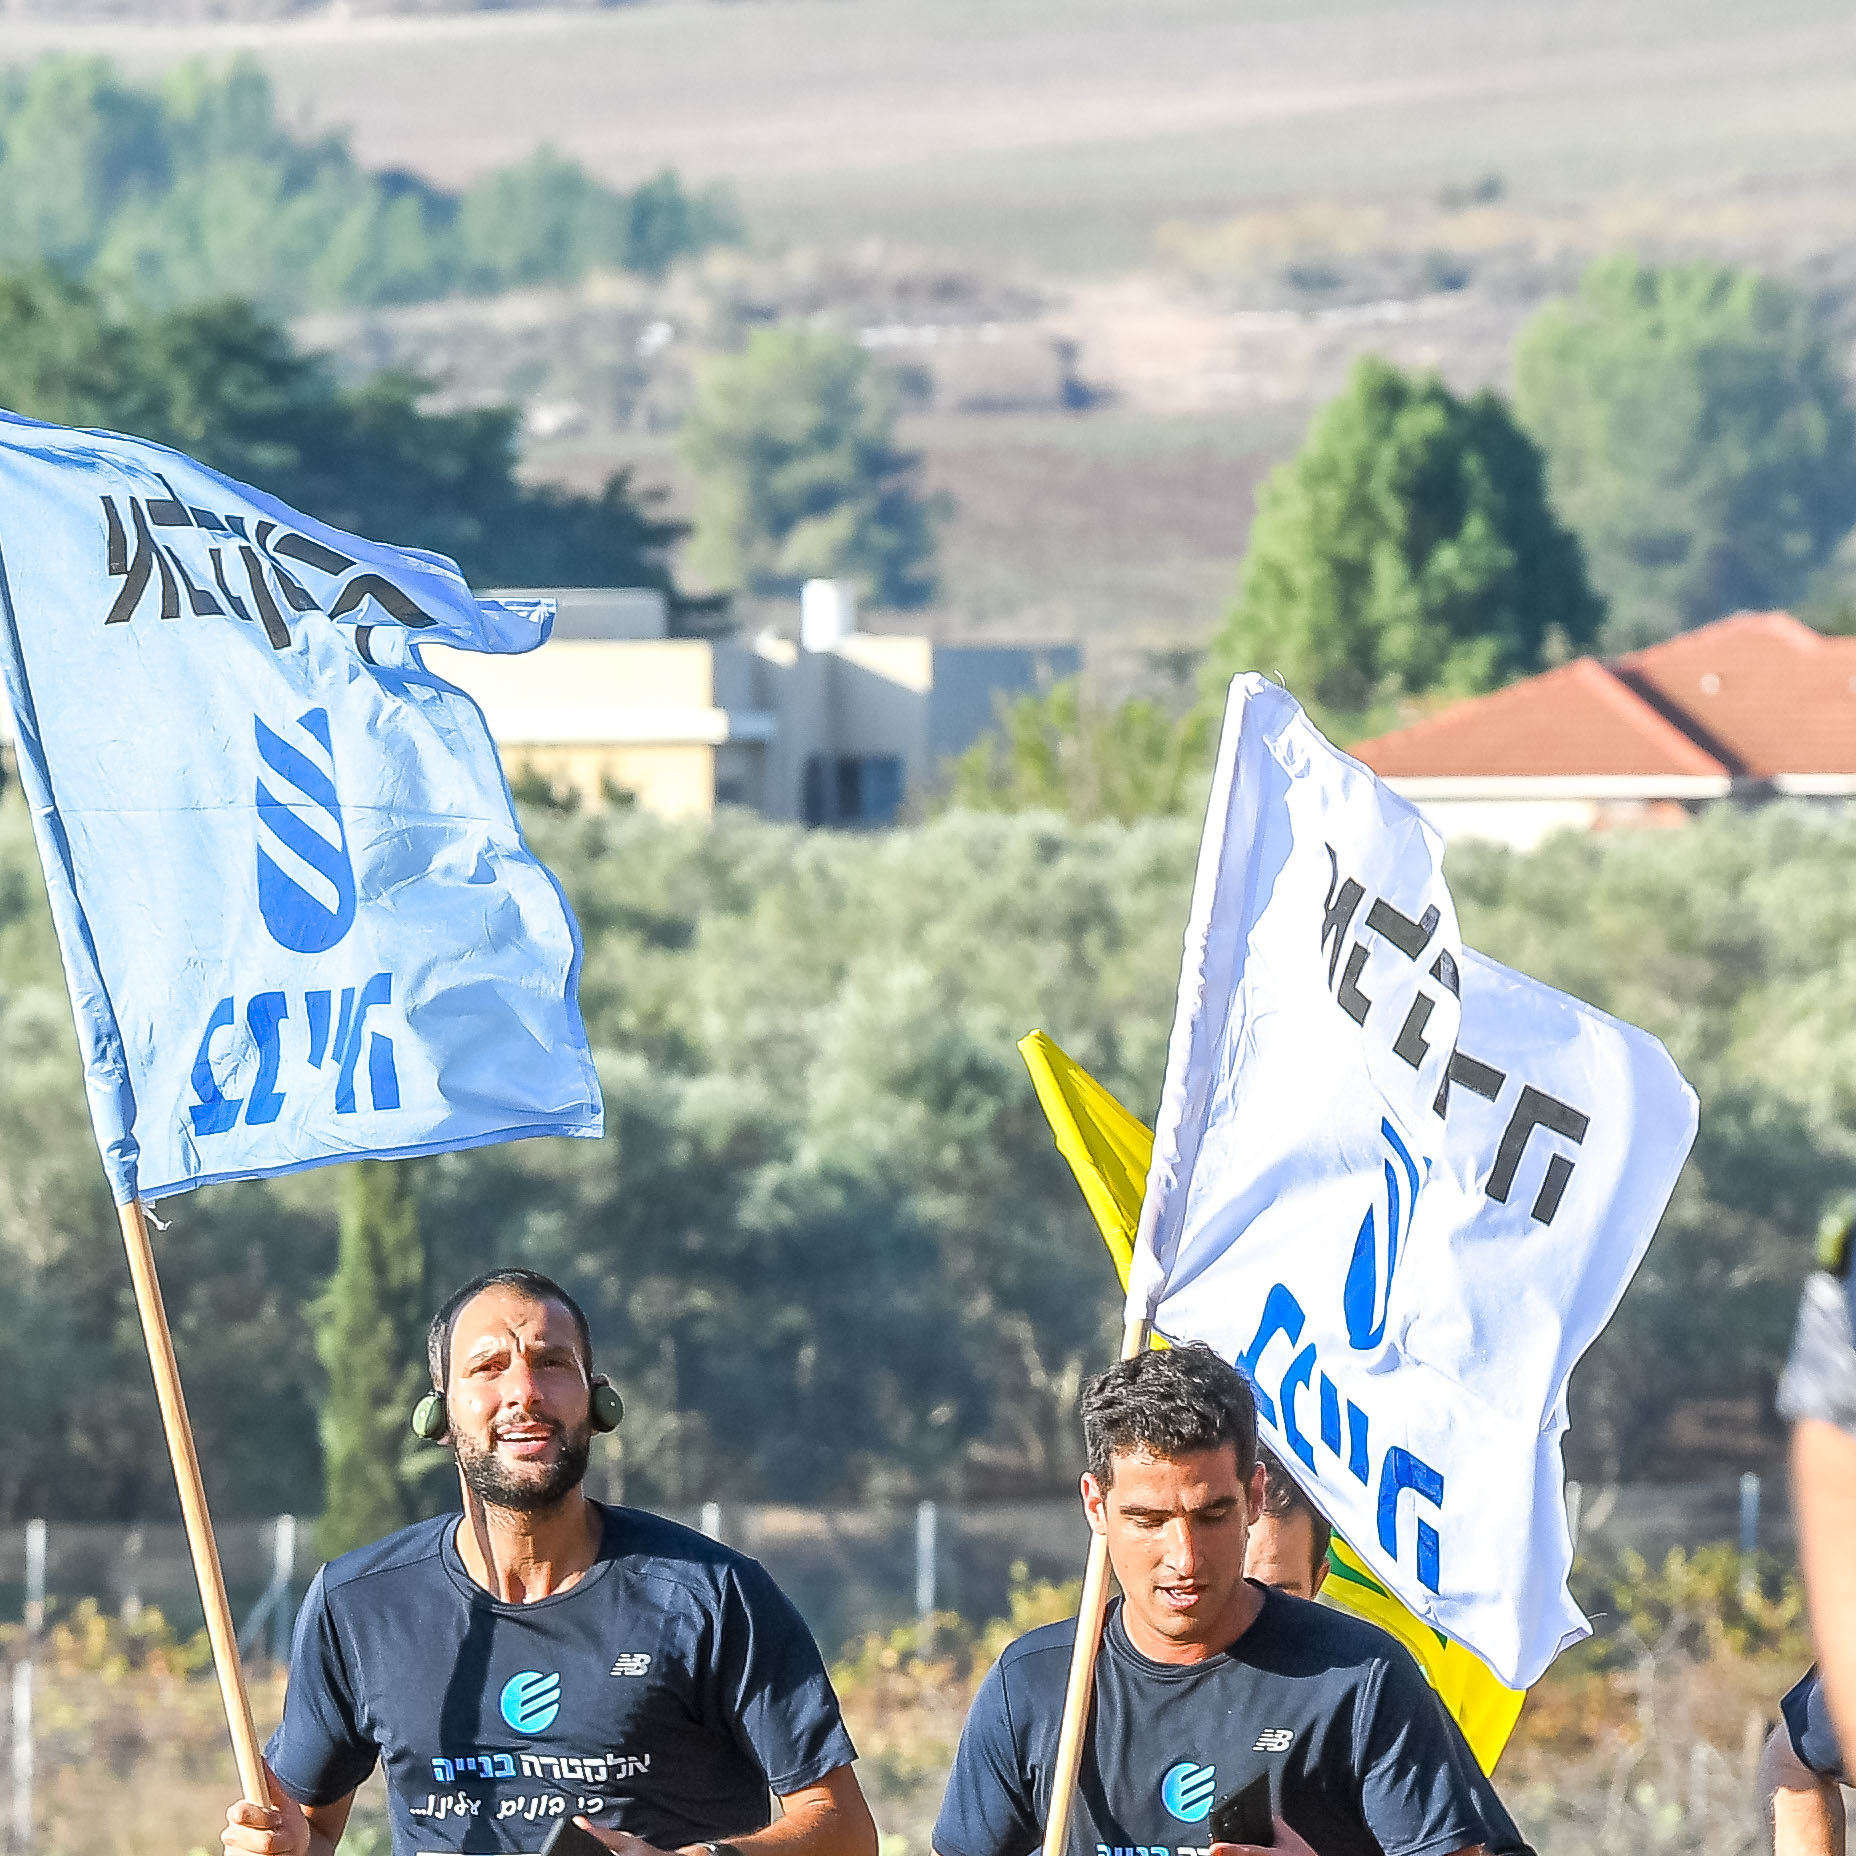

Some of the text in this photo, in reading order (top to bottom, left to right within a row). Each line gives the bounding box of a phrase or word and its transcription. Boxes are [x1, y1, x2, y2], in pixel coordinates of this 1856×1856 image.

[431, 1753, 651, 1783] אלקטרה בנייה
[496, 1794, 566, 1821] בונים
[577, 1796, 605, 1814] כי
